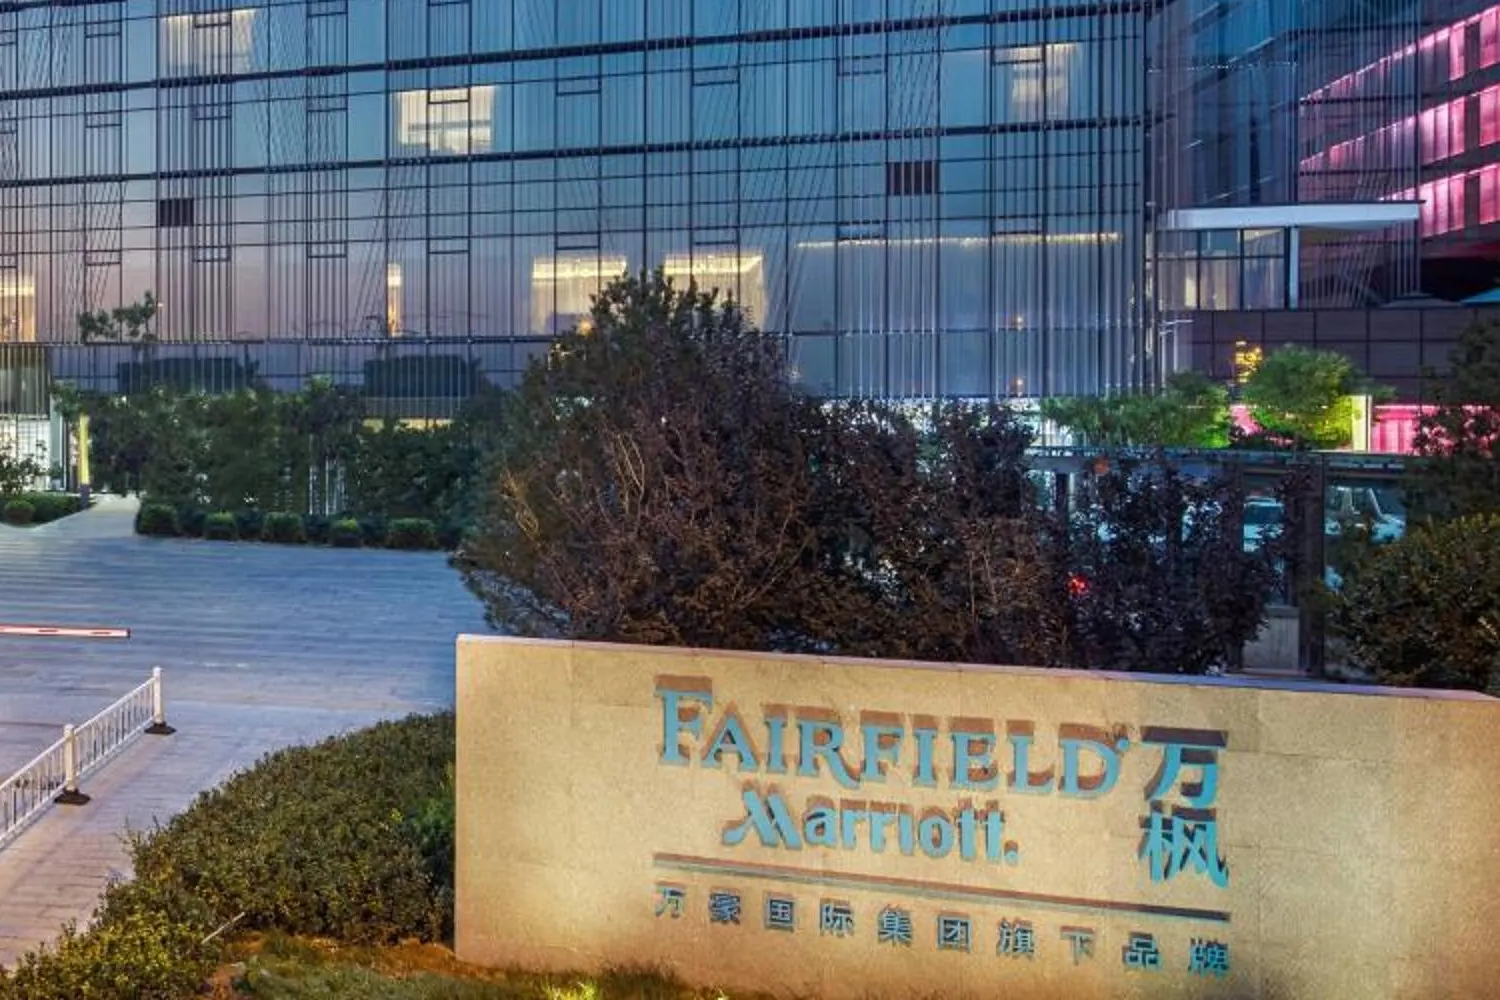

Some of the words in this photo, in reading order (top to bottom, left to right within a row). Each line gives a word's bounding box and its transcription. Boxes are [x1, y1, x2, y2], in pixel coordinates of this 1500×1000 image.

[1137, 725, 1230, 890] 万枫
[655, 880, 1232, 980] 万豪国际集团旗下品牌
